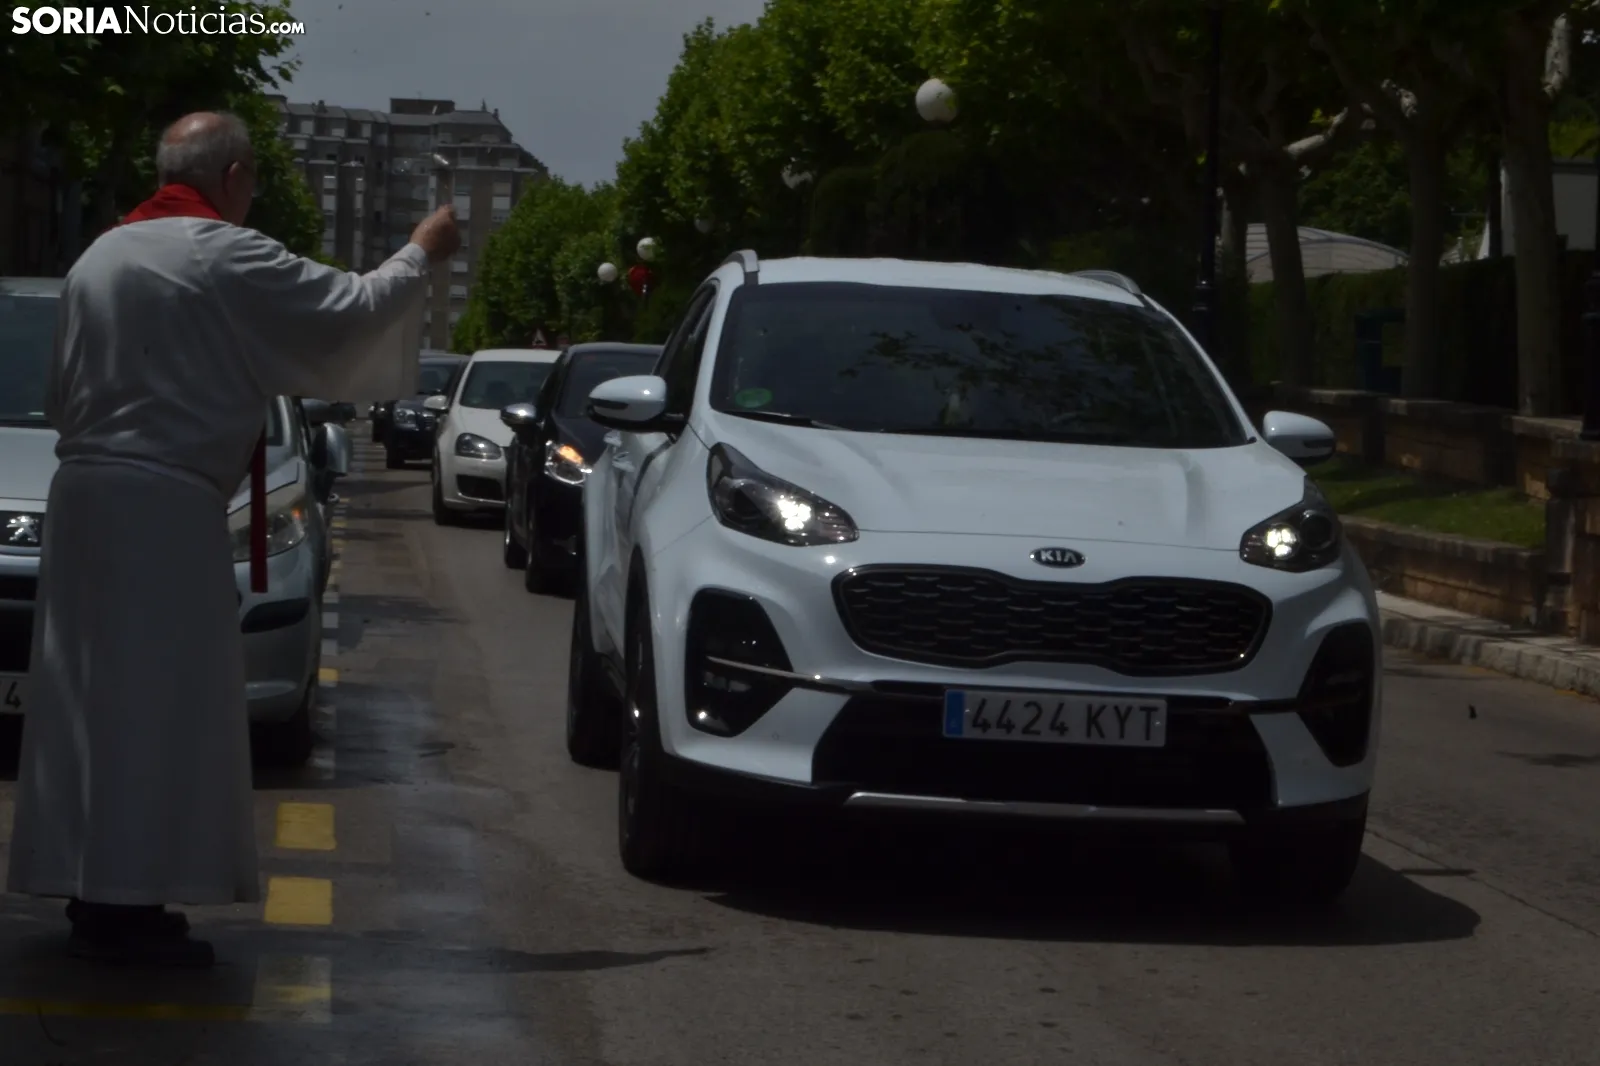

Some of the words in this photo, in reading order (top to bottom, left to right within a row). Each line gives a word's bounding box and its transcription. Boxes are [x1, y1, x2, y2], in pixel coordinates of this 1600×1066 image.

[1040, 549, 1077, 563] KIA
[972, 698, 1069, 737] 4424
[1086, 703, 1159, 741] KYT
